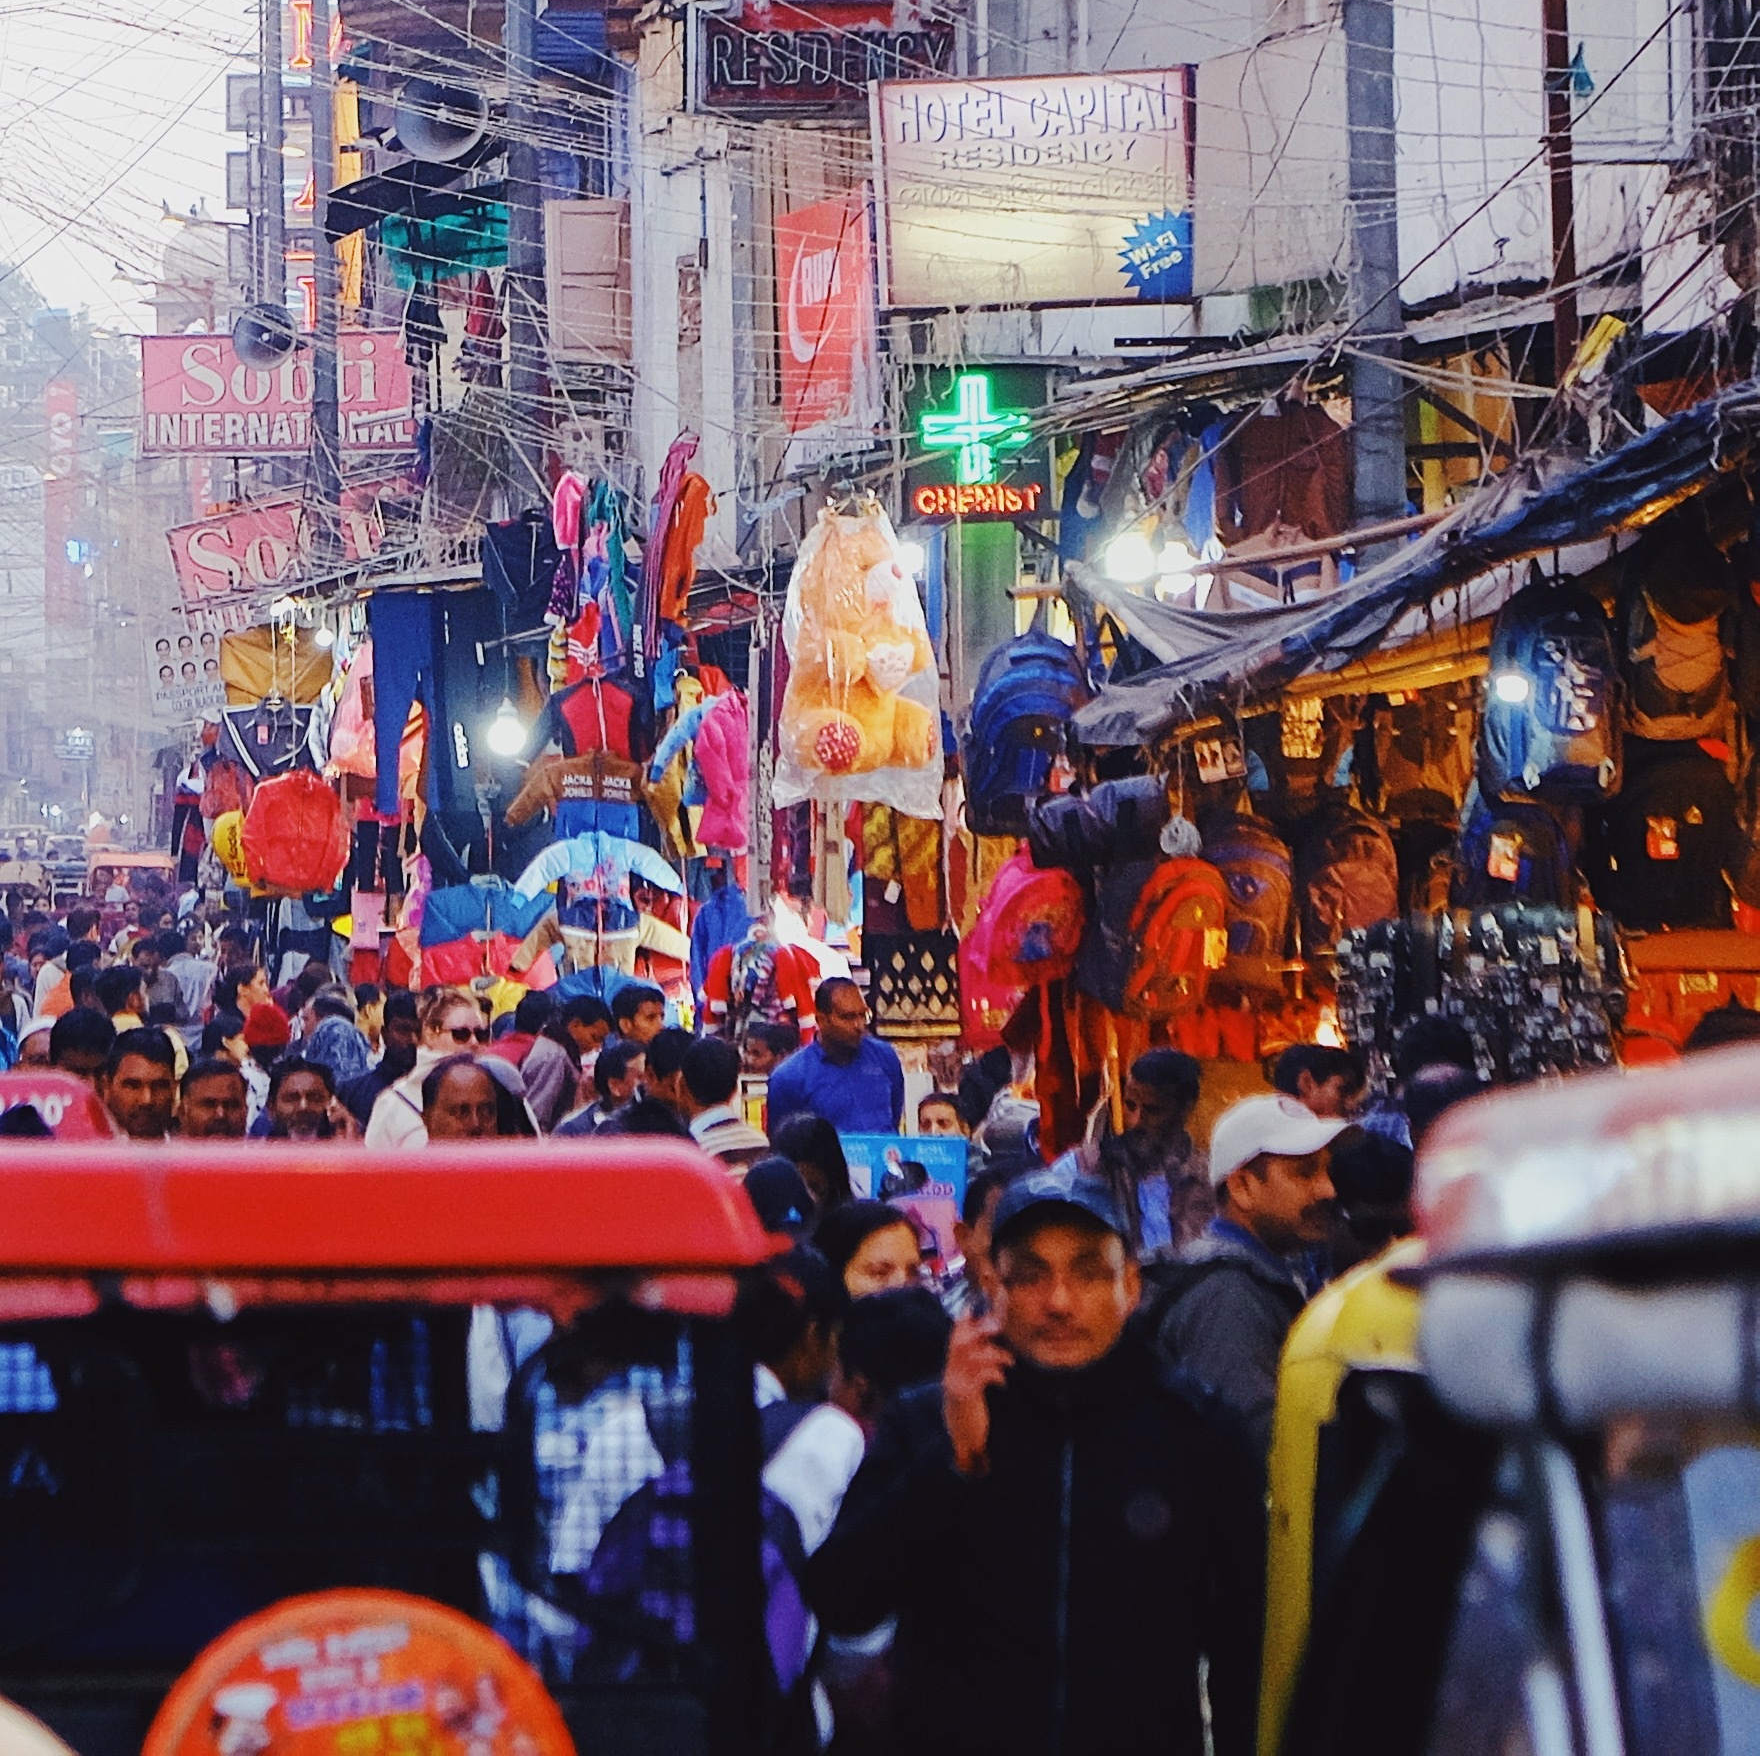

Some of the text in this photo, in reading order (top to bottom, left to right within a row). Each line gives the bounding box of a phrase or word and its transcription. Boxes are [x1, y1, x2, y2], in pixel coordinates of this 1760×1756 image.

[712, 33, 947, 87] RESIDENCY
[895, 81, 1178, 143] HOTEL CAPITAL
[939, 139, 1137, 171] RESIDENCY
[1127, 229, 1179, 266] Wi-Fi
[1139, 249, 1184, 281] Free
[146, 411, 415, 446] INTERNATONAL
[916, 483, 1041, 515] CHEMIST
